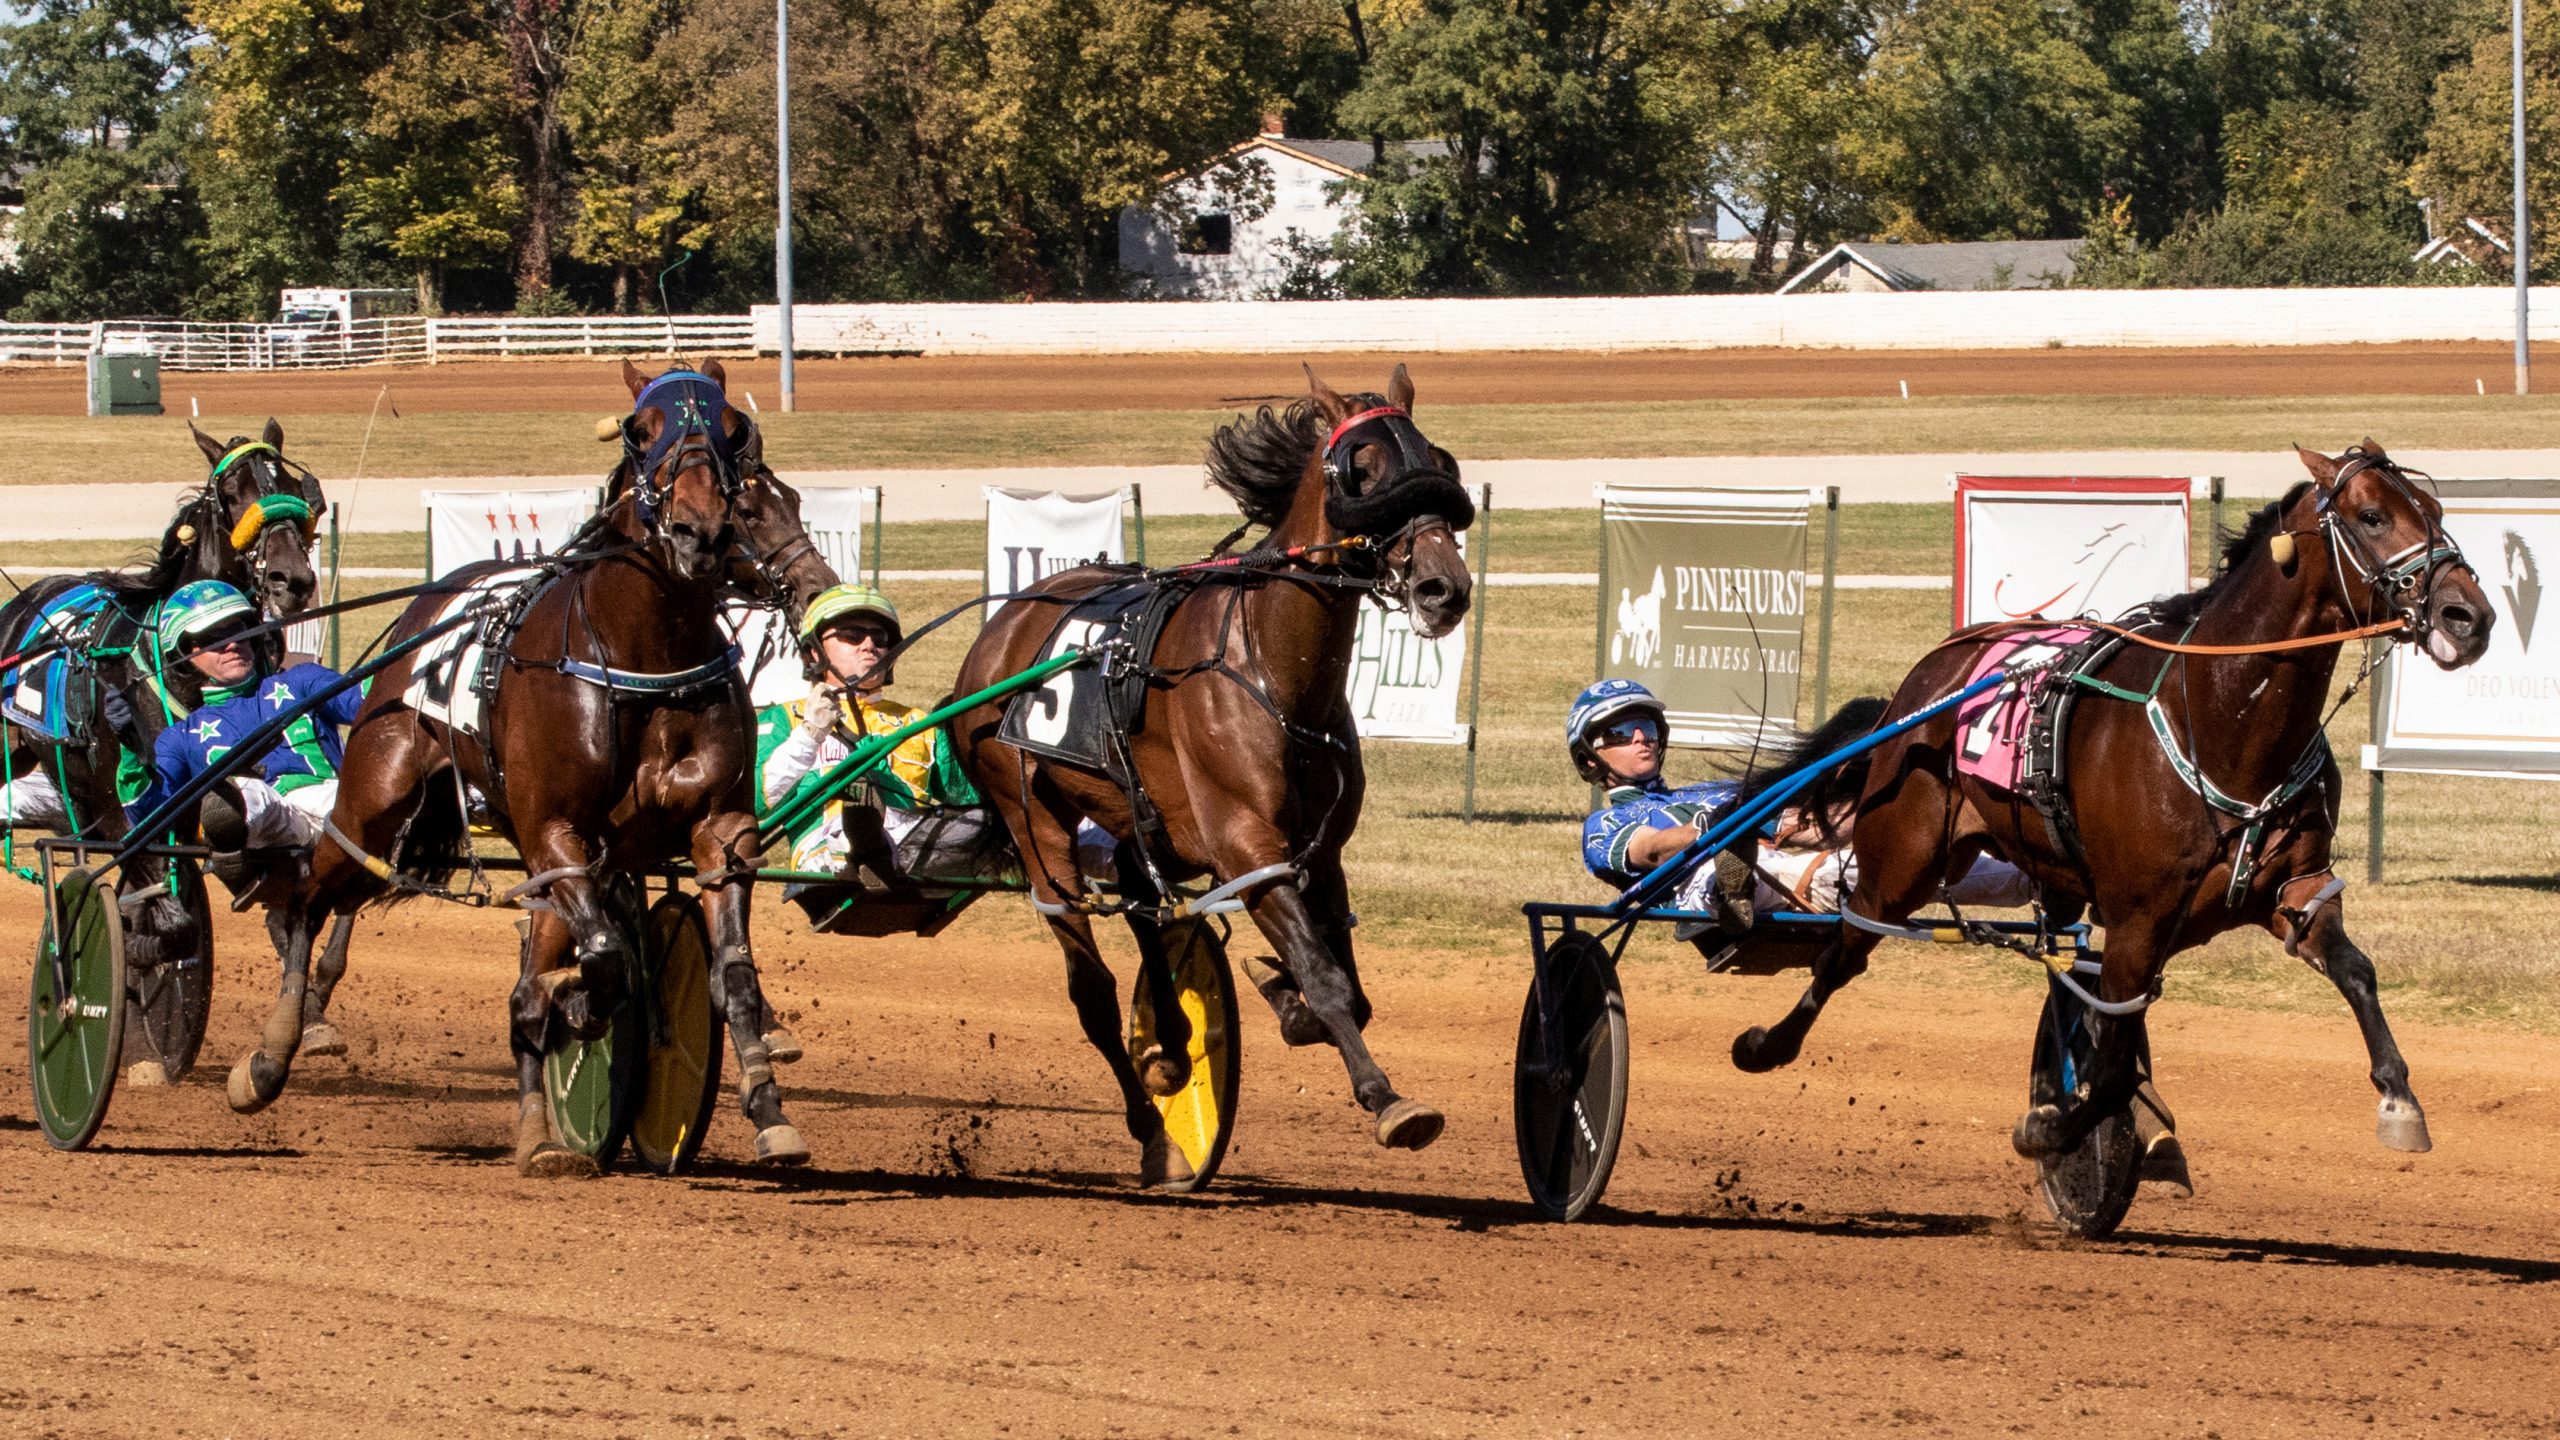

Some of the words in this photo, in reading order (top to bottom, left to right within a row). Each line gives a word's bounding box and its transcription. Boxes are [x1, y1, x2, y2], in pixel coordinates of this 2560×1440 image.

[1674, 566, 1805, 615] PINEHURST
[1026, 619, 1106, 746] 5
[1673, 644, 1751, 672] HARNESS
[1961, 637, 2063, 763] 7
[2467, 675, 2501, 698] DEO
